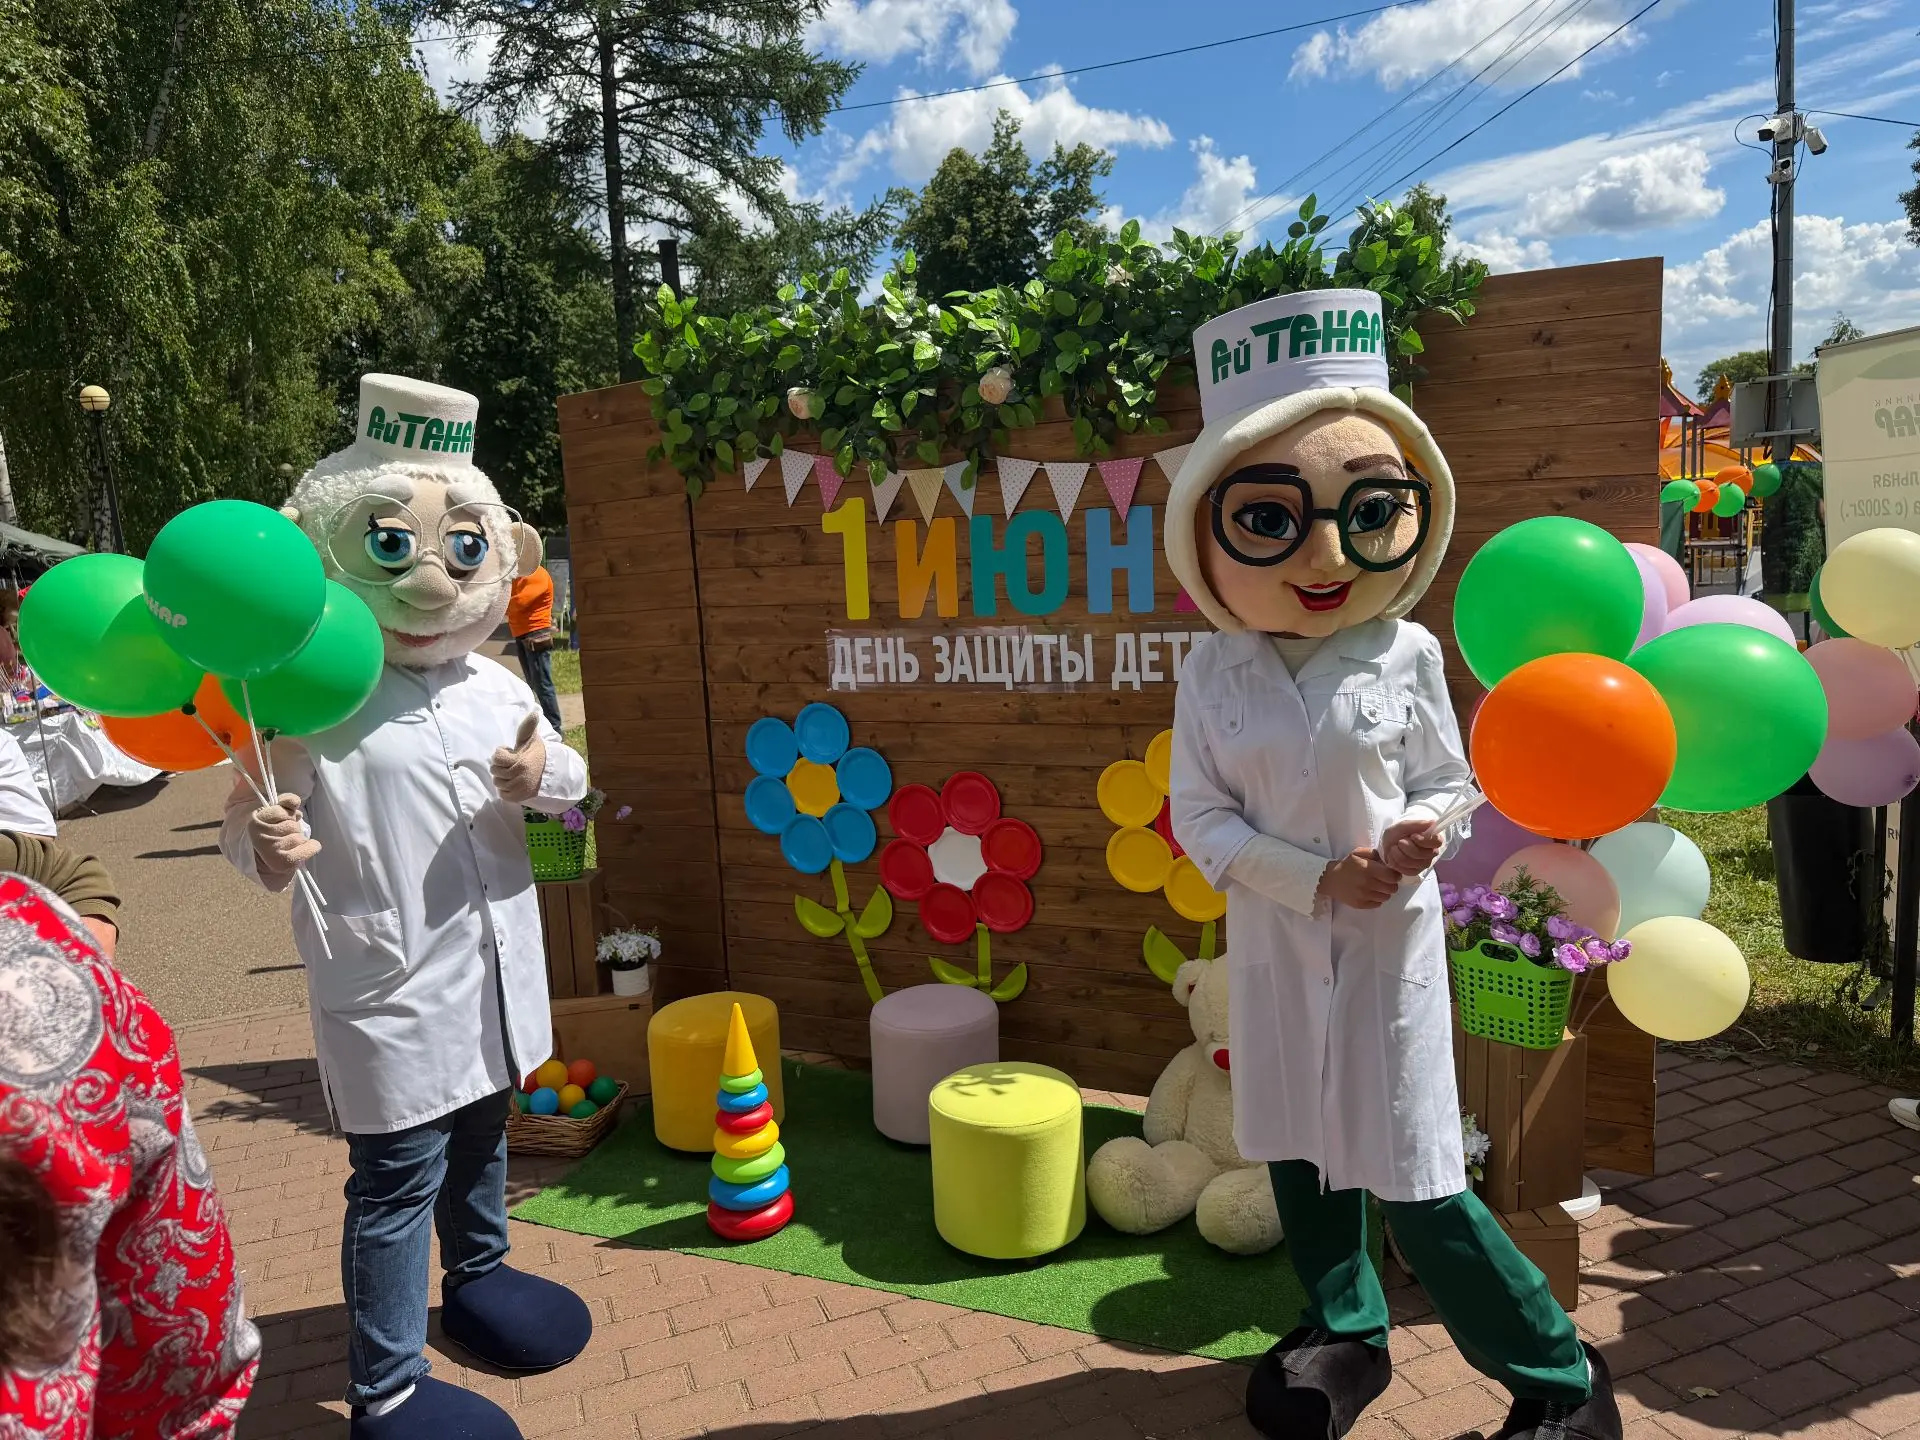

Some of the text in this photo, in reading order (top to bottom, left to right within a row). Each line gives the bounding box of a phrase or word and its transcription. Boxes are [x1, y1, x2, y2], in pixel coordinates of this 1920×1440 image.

[822, 497, 1198, 620] 1 ИЮН
[831, 636, 920, 690] ДЕНЬ
[932, 633, 1094, 690] ЗАЩИТЫ
